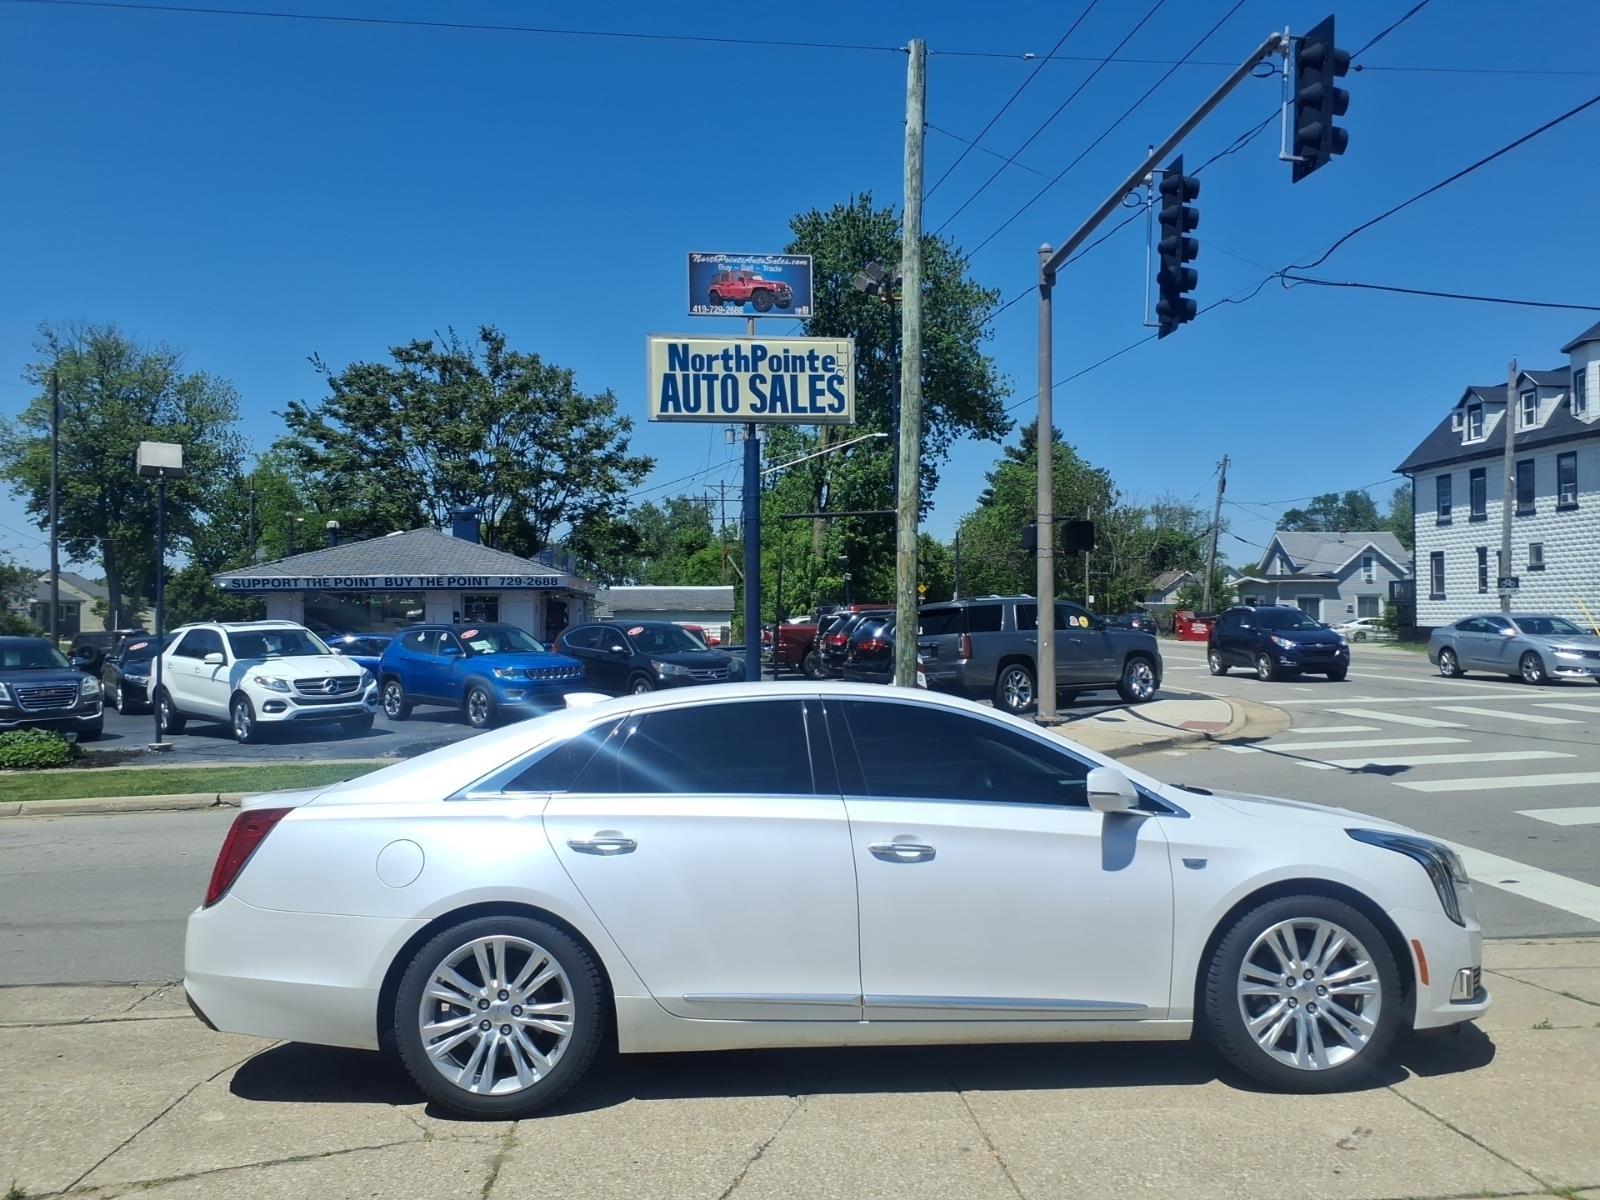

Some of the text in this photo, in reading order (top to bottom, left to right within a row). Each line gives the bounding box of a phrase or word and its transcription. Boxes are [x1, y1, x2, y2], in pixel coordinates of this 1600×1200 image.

[692, 254, 808, 266] NorthPointeAutoSales.com
[718, 263, 732, 272] Buy
[741, 264, 754, 272] Sell
[668, 343, 836, 373] NorthPointe
[659, 373, 845, 414] AUTO SALES
[231, 576, 558, 588] SUPPORT THE POINT BUY THE POINT 729-2688
